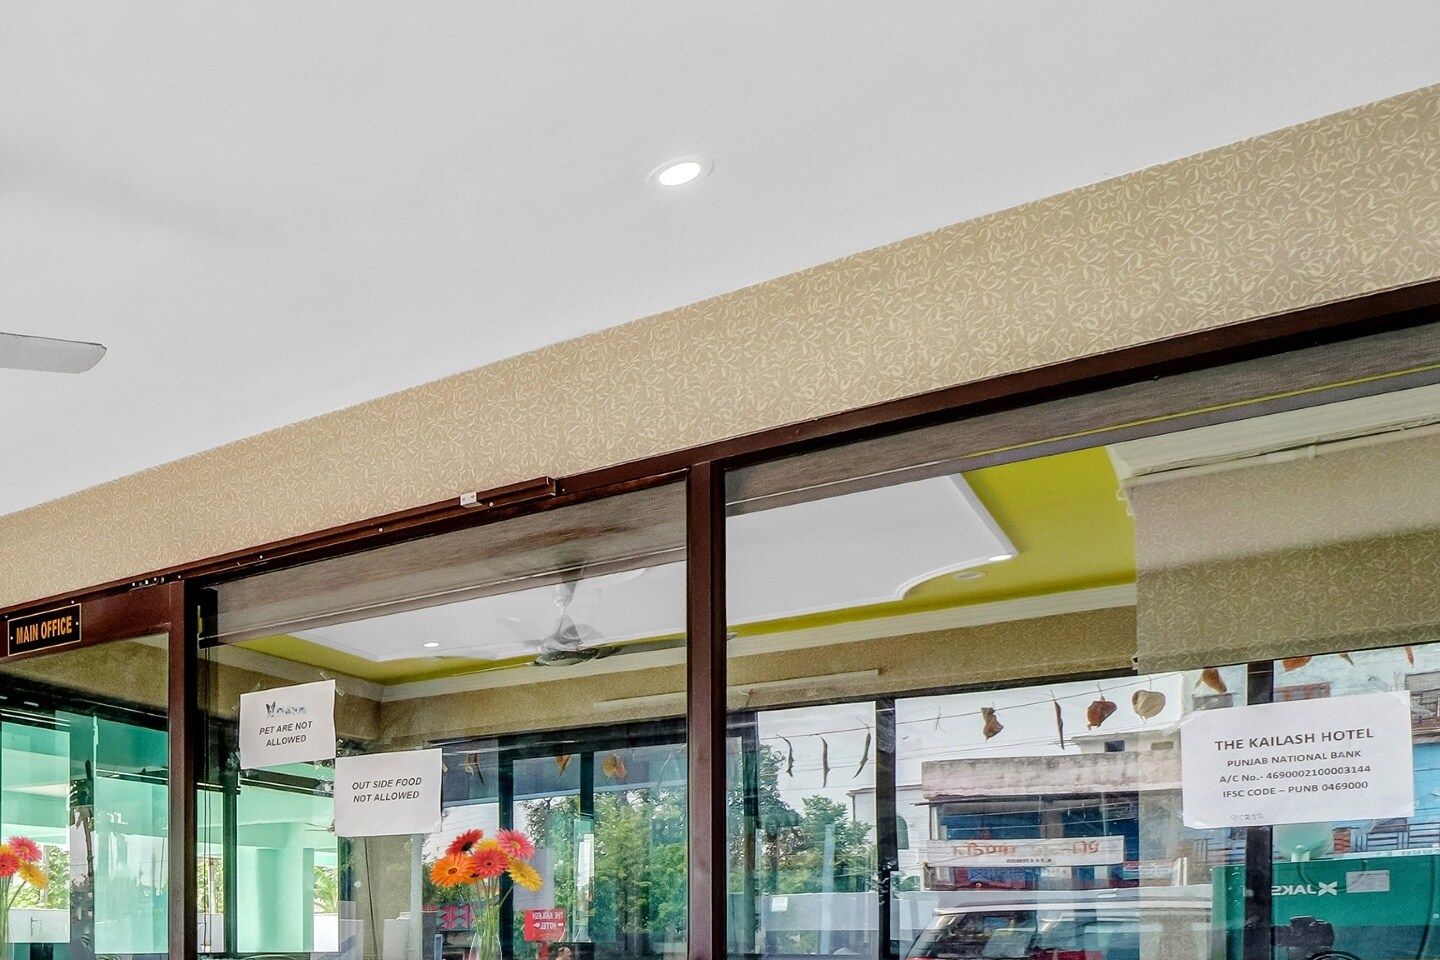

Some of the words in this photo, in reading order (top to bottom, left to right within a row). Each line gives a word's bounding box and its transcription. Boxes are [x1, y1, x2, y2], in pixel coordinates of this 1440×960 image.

[16, 624, 39, 645] MAIN
[41, 616, 72, 639] OFFICE
[259, 727, 275, 736] PET
[276, 724, 293, 733] ARE
[295, 721, 313, 730] NOT
[266, 734, 307, 747] ALLOWED
[1214, 739, 1244, 751] THE
[1249, 733, 1315, 748] KAILASH
[1322, 728, 1374, 742] HOTEL
[1227, 758, 1268, 767] PUNJAB
[1272, 753, 1327, 764] NATIONAL
[1330, 750, 1362, 759] BANK
[352, 781, 371, 791] OUT
[372, 779, 394, 789] SIDE
[395, 777, 423, 787] FOOD
[1220, 775, 1239, 784] A/C
[353, 794, 373, 803] NOT
[374, 790, 420, 802] ALLOWED
[1223, 790, 1245, 798] IFSC
[1247, 788, 1277, 797] CODE
[1288, 784, 1319, 794] PUNB
[1322, 781, 1369, 791] 0469000
